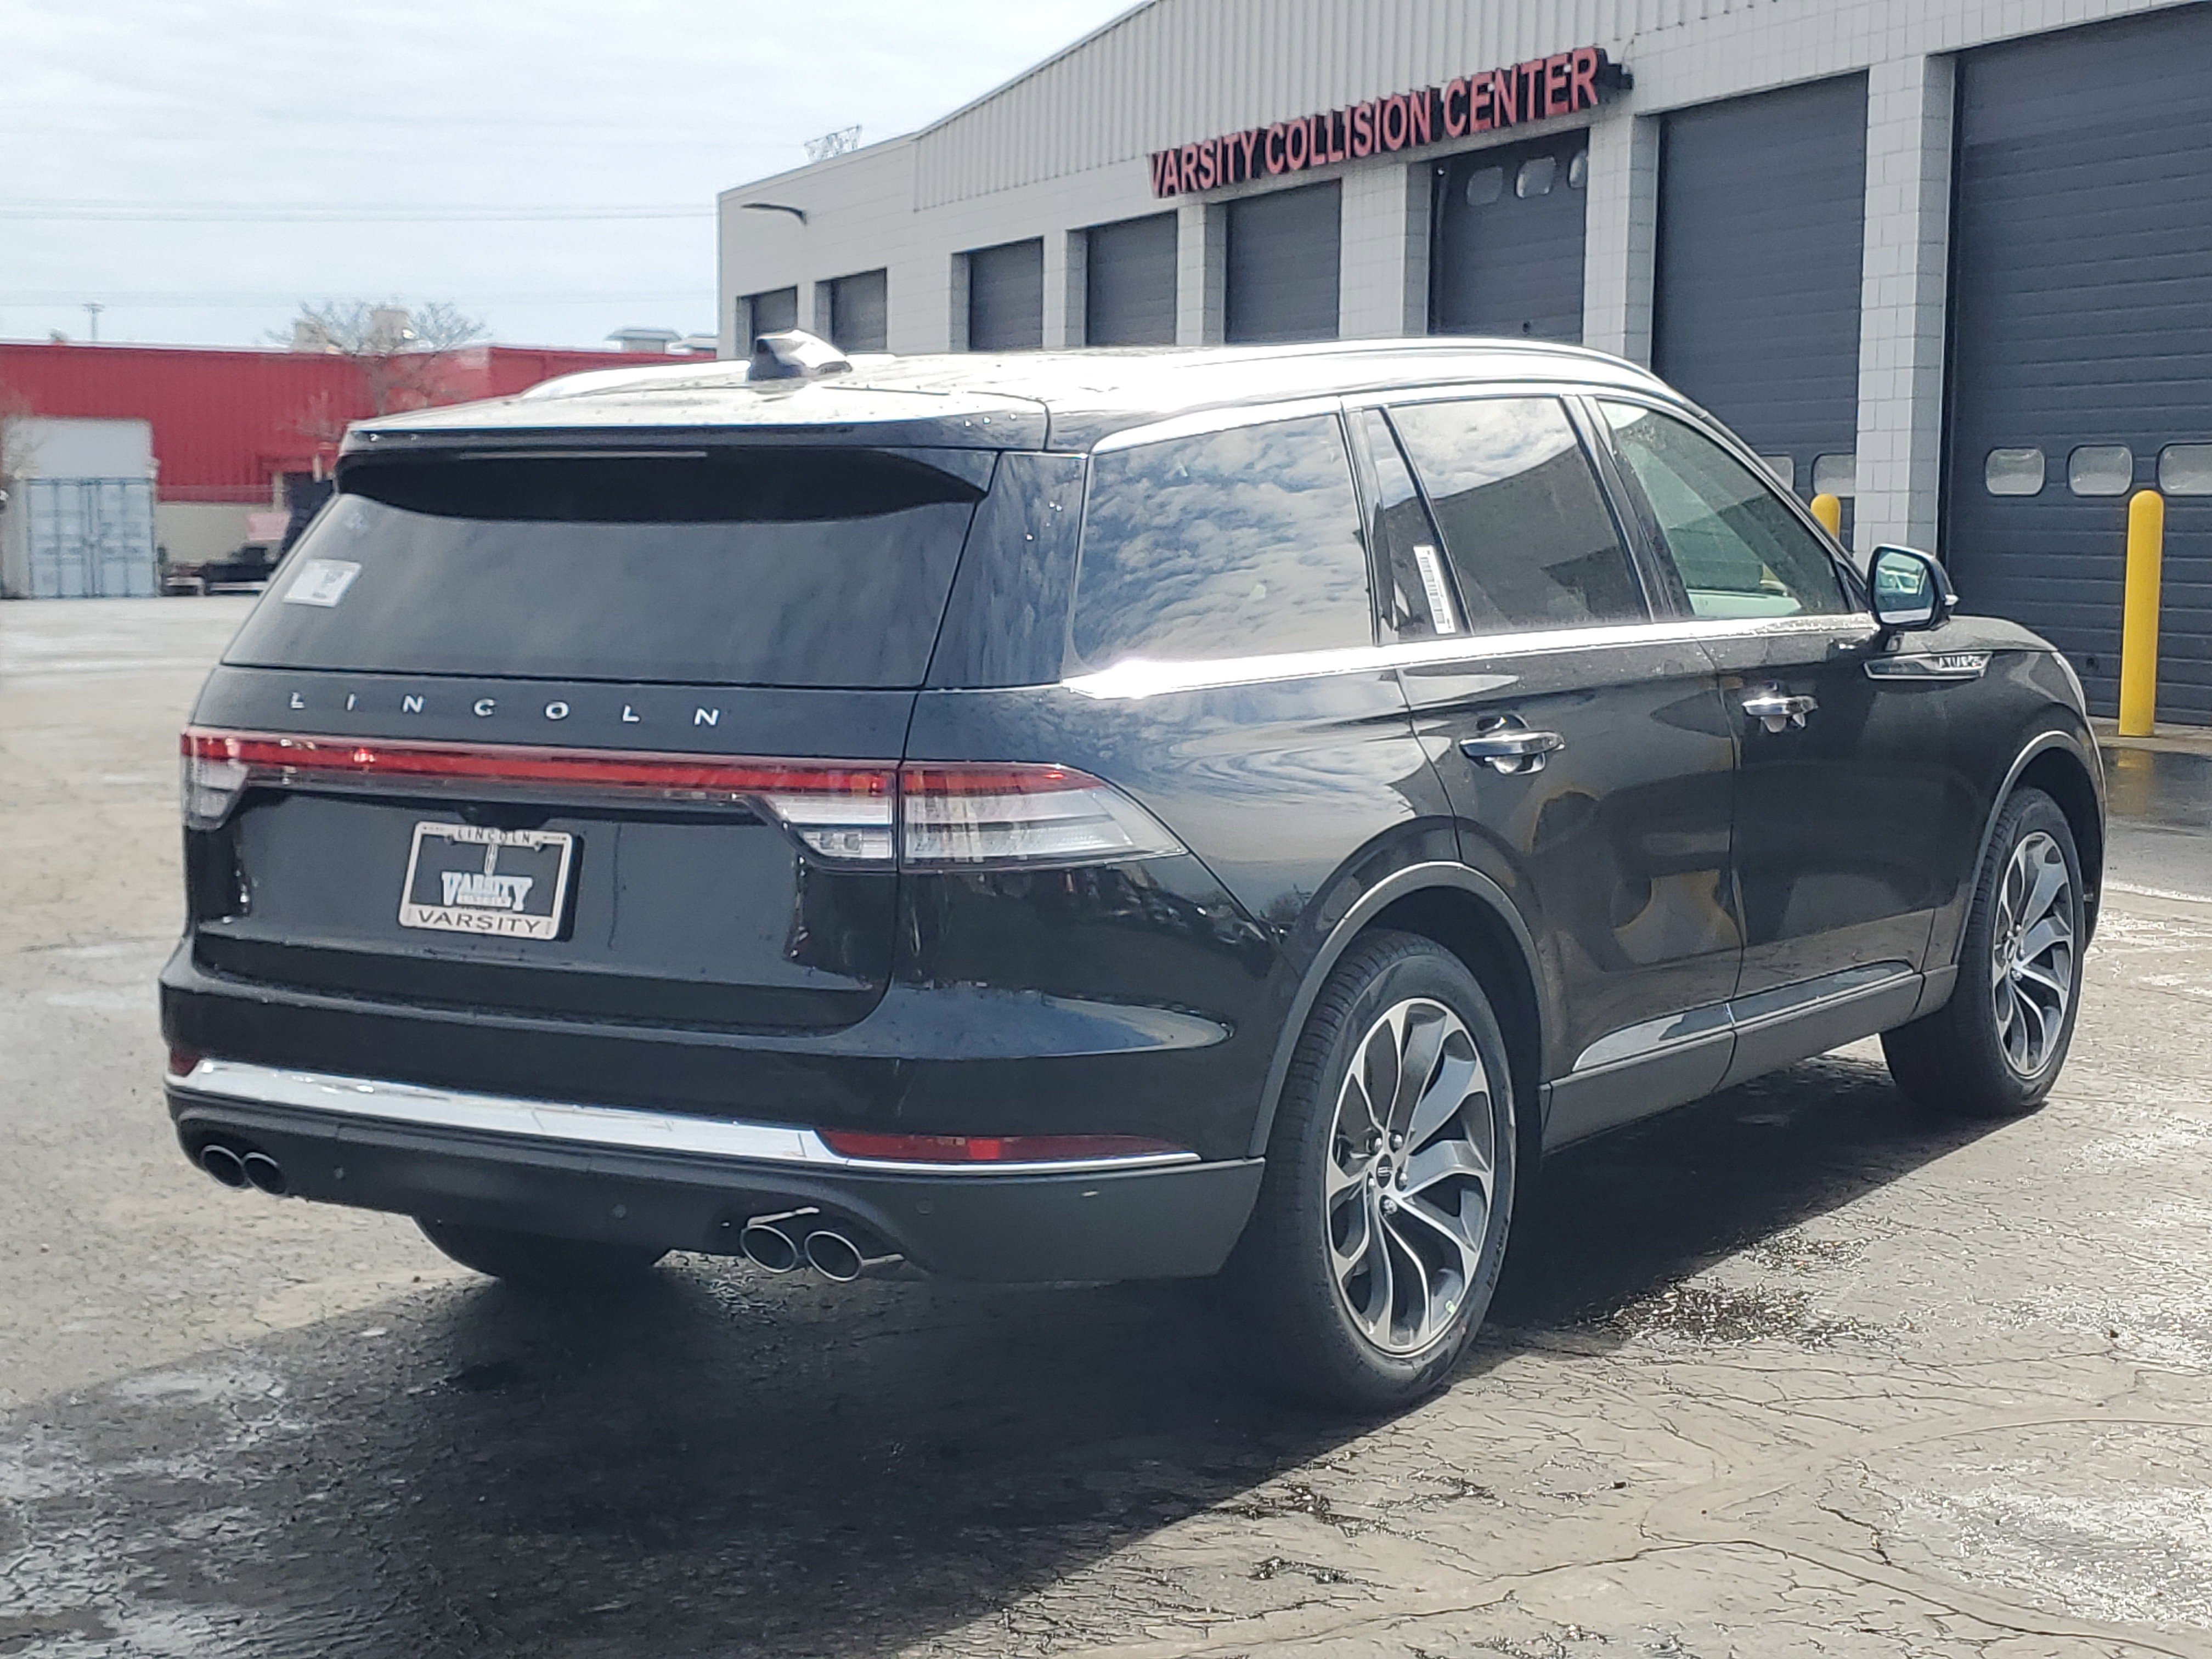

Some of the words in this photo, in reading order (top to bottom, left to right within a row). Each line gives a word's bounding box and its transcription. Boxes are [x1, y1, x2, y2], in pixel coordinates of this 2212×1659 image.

[1147, 129, 1259, 198] VARSITY
[1265, 87, 1431, 174] COLLISION
[1443, 46, 1599, 138] CENTER
[290, 692, 720, 727] LINCOLN
[458, 827, 531, 844] LINCOLN
[418, 909, 541, 934] VARSITY
